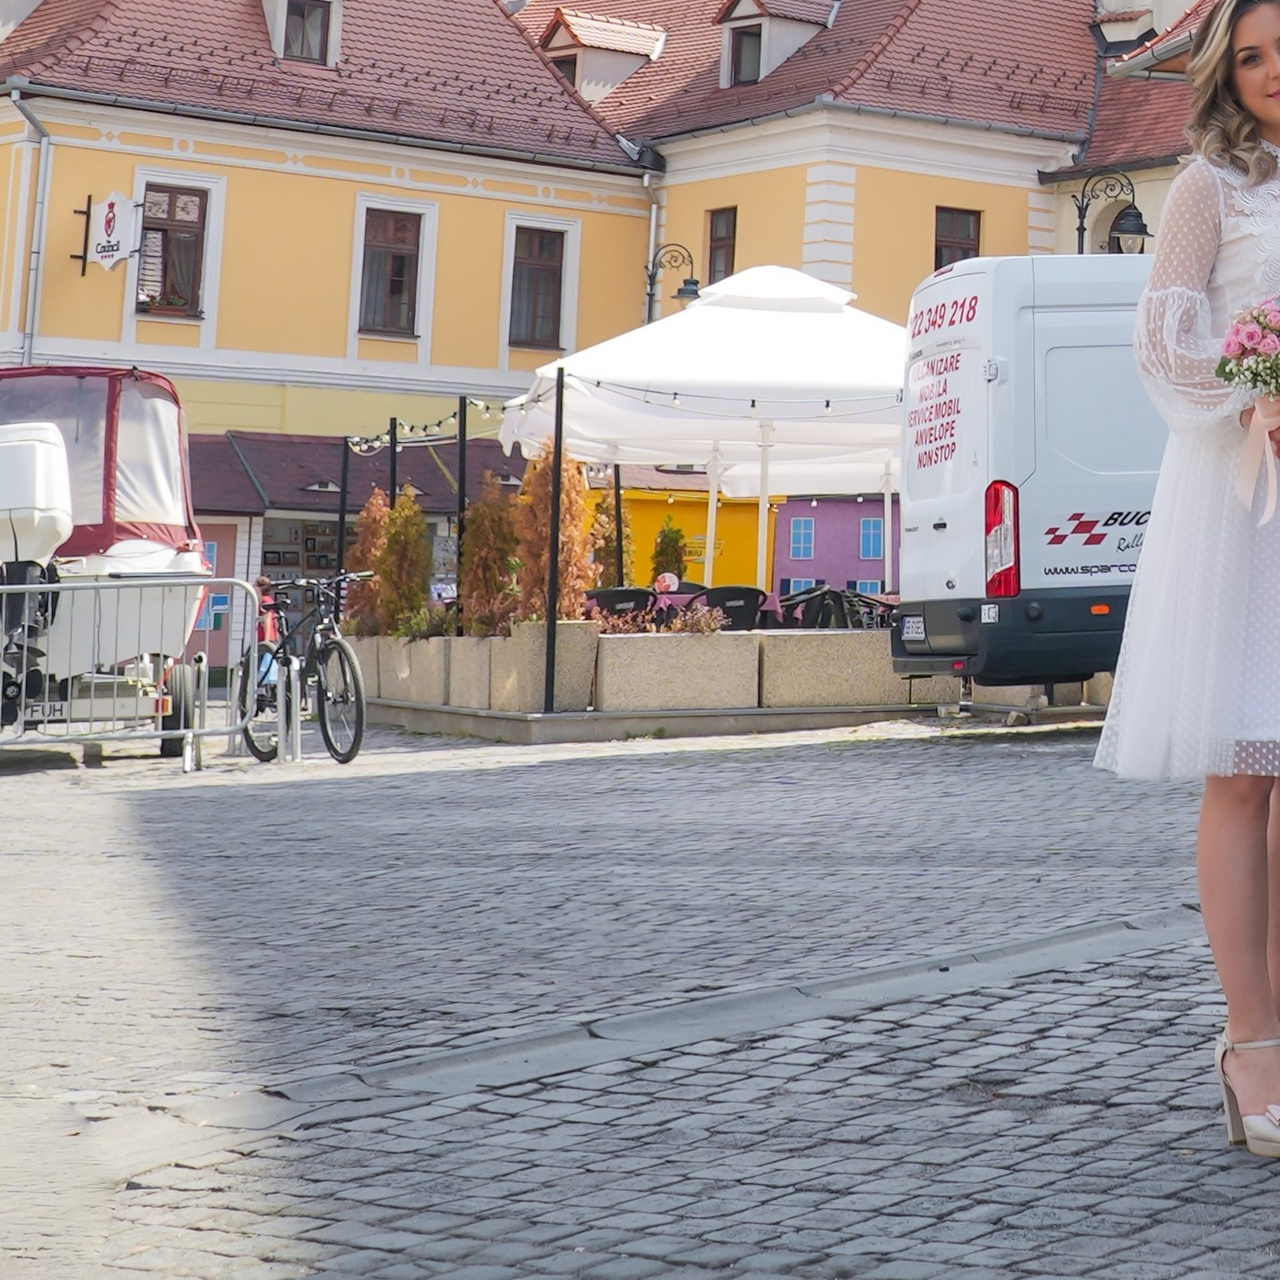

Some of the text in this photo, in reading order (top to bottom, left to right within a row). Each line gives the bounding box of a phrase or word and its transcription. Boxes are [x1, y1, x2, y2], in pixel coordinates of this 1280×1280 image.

[924, 302, 947, 334] 349
[948, 295, 978, 327] 218
[934, 397, 961, 420] MOBIL
[914, 420, 956, 447] ANVELOPE
[917, 442, 957, 469] NON STOP
